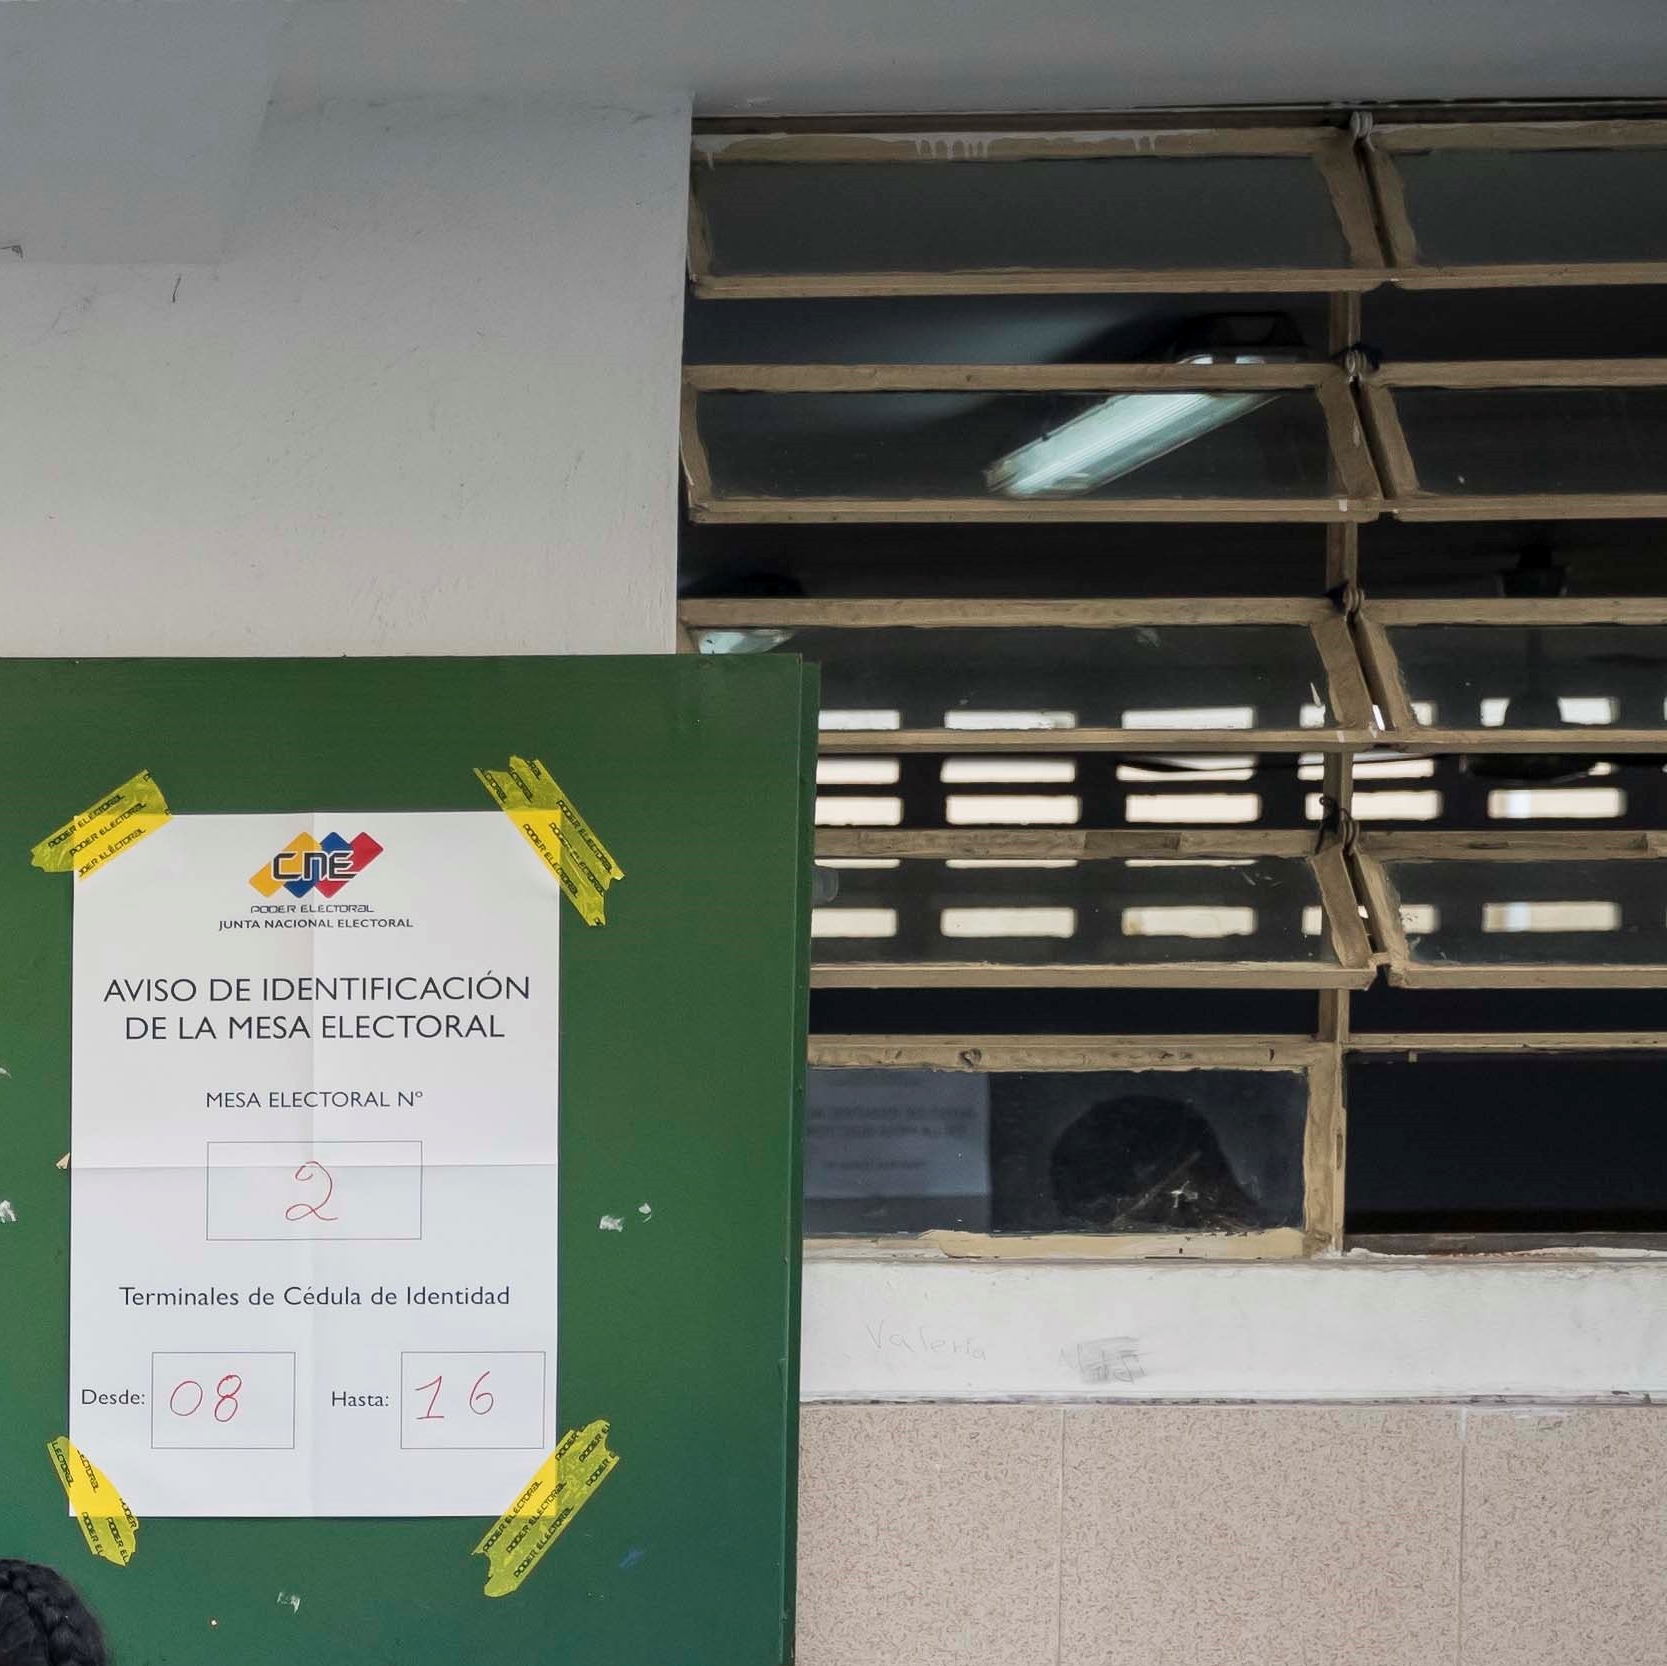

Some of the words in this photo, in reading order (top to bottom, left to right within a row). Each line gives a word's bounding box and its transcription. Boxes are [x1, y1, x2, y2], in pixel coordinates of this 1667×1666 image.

[48, 826, 77, 848] PODER
[77, 794, 125, 829] ELECTORAL
[69, 833, 98, 857] PODER
[99, 802, 146, 836] ELECTORAL
[99, 828, 146, 861] ELECTORAL
[556, 800, 581, 830] PODER
[578, 828, 613, 875] ELECTORAL
[273, 852, 358, 880] CNE
[523, 823, 547, 852] PODER
[544, 851, 579, 898] ELECTORAL
[219, 919, 260, 931] JUNTA
[265, 919, 333, 929] NACIONAL
[338, 919, 414, 928] ELECTORAL
[251, 905, 296, 914] PODER
[301, 904, 374, 914] ELECTORAL
[104, 978, 197, 1002] AVISO
[210, 978, 251, 1002] DE
[264, 970, 530, 1001] IDENTIFICACIÓN
[126, 1017, 167, 1040] DE
[179, 1017, 216, 1039] LA
[229, 1016, 311, 1039] MESA
[322, 1015, 505, 1038] ELECTORAL
[206, 1091, 262, 1109] MESA
[269, 1091, 391, 1108] ELECTORAL
[284, 1160, 338, 1221] 2
[119, 1286, 240, 1306] Terminales
[248, 1286, 275, 1306] de
[283, 1286, 362, 1306] Cédula
[370, 1286, 398, 1306] de
[407, 1285, 511, 1305] Identidad
[81, 1388, 146, 1406] Desde:
[170, 1375, 242, 1422] 08
[331, 1390, 390, 1408] Hasta:
[415, 1371, 494, 1420] 16
[554, 1432, 579, 1461] PODER
[579, 1433, 603, 1463] PODER
[586, 1458, 610, 1487] PODER
[82, 1511, 99, 1542] PODER
[107, 1516, 124, 1548] PODER
[482, 1523, 507, 1553] PODER
[505, 1480, 543, 1525] ELECTORAL
[506, 1526, 530, 1553] PODER
[528, 1481, 567, 1525] ELECTORAL
[514, 1549, 538, 1578] PODER
[536, 1506, 574, 1550] ELECTORAL
